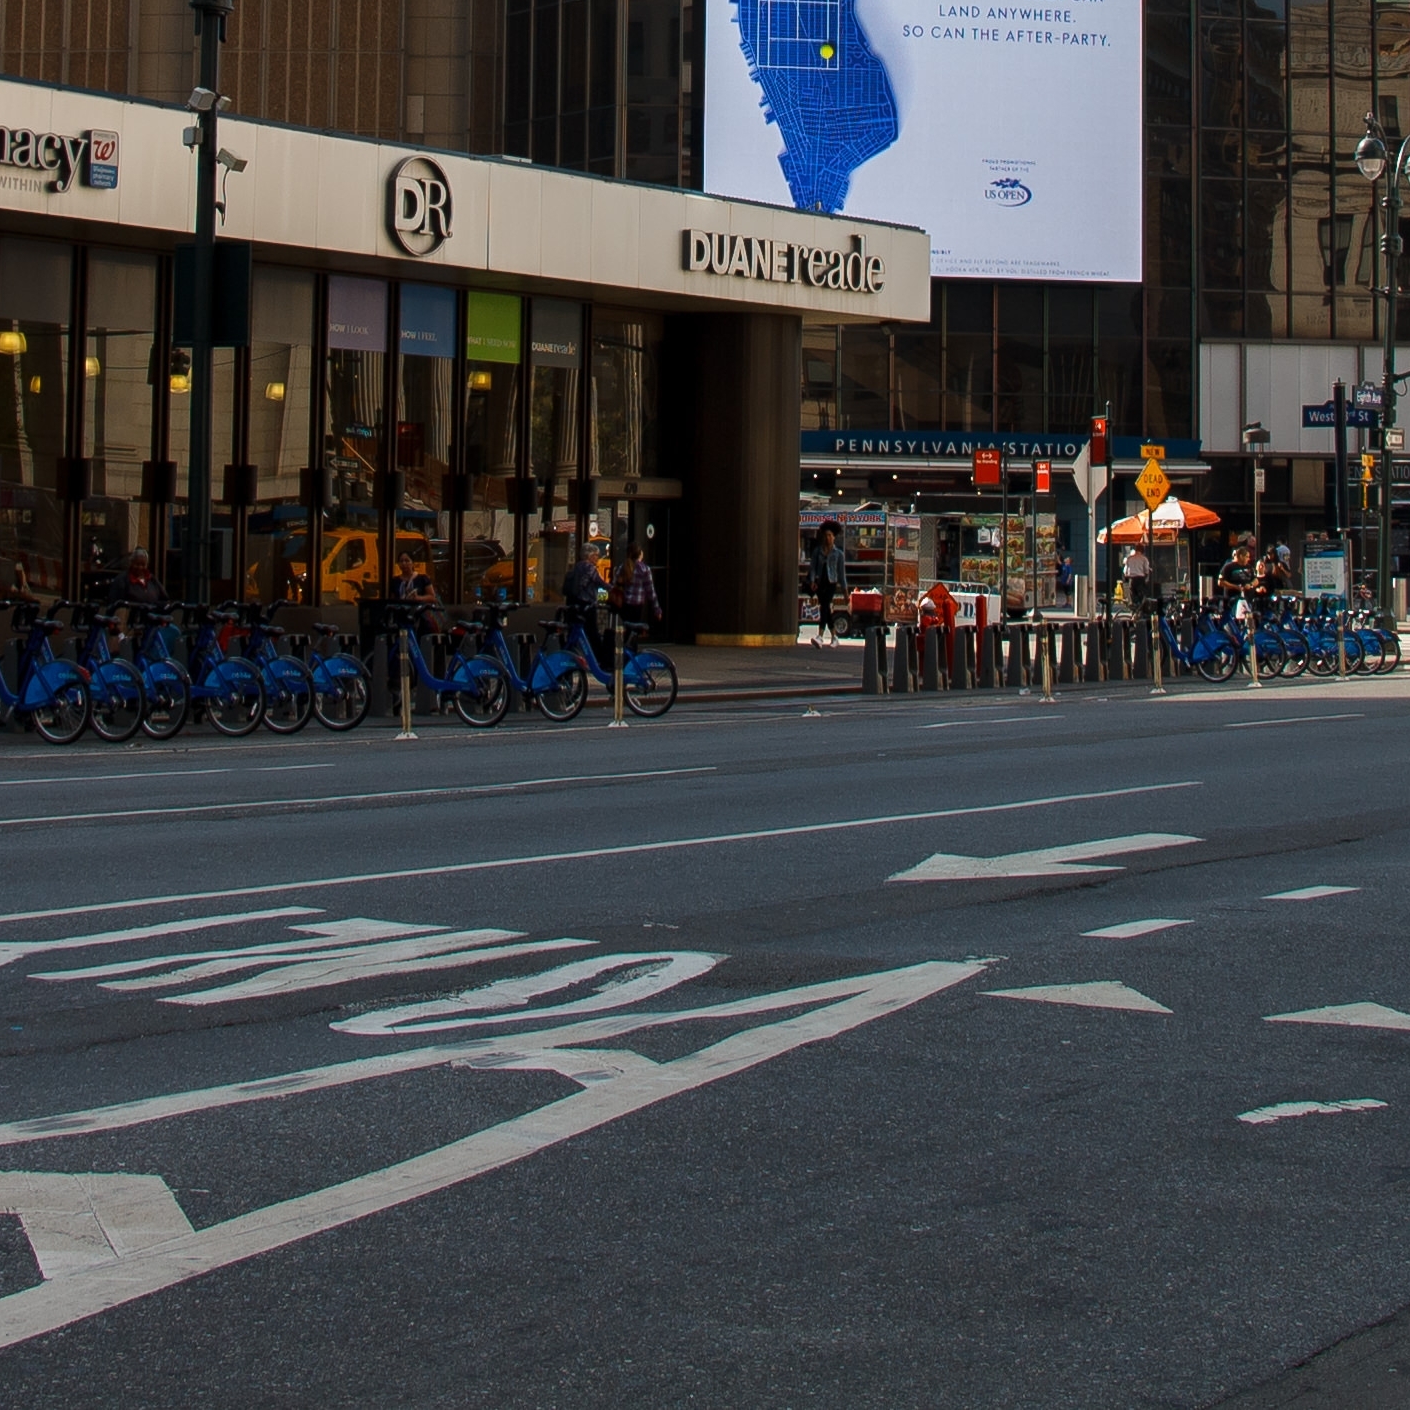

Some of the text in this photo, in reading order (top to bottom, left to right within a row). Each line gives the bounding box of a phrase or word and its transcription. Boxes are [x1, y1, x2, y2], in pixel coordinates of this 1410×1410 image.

[938, 3, 1076, 24] LAND ANYWHERE.
[902, 24, 1111, 48] SO CAN THE AFTER-PARTY.
[984, 189, 1024, 200] US OPEN
[394, 175, 455, 238] DR
[1308, 410, 1335, 422] West
[1358, 410, 1369, 422] St
[1145, 447, 1161, 457] NEW
[1143, 473, 1163, 484] DEAD
[1146, 487, 1160, 497] END
